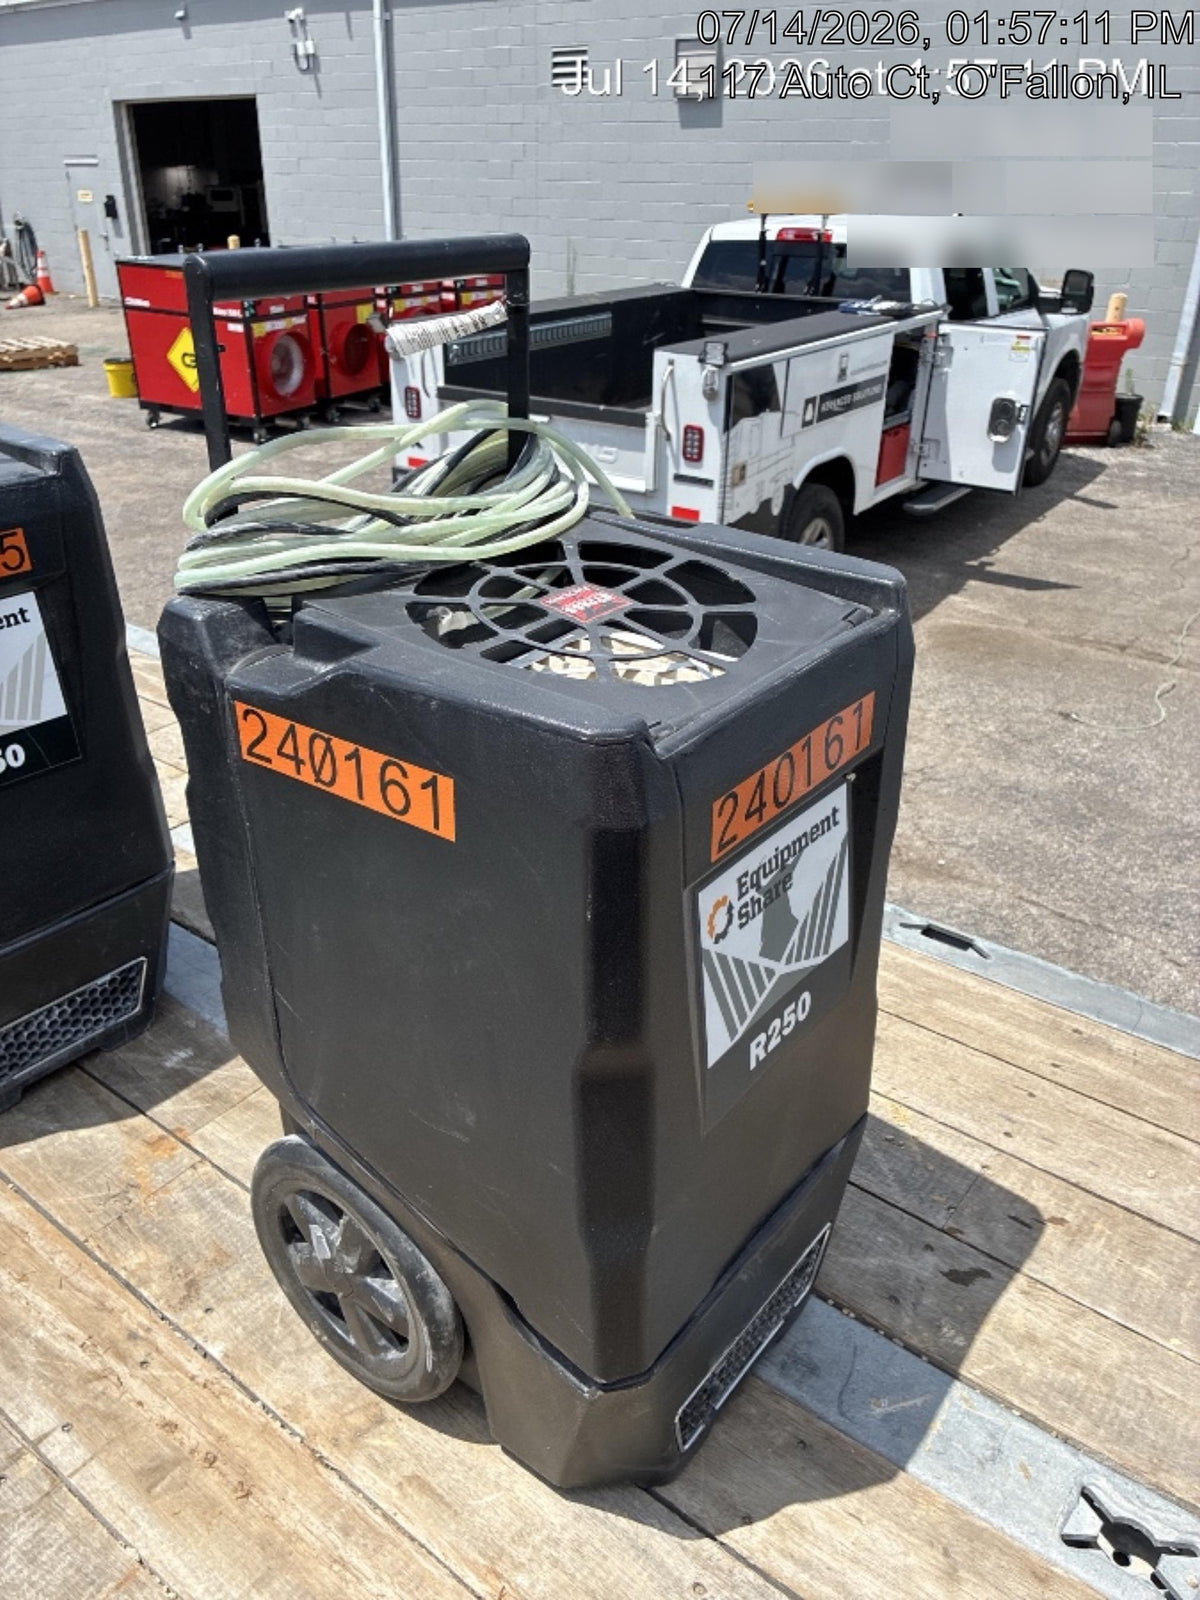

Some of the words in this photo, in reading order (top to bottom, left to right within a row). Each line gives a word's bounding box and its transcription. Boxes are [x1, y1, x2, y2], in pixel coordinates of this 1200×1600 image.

[243, 708, 441, 831] 240161
[717, 702, 863, 854] 240161
[736, 806, 840, 901] Equipment
[737, 872, 794, 930] Share
[749, 990, 812, 1072] R250
